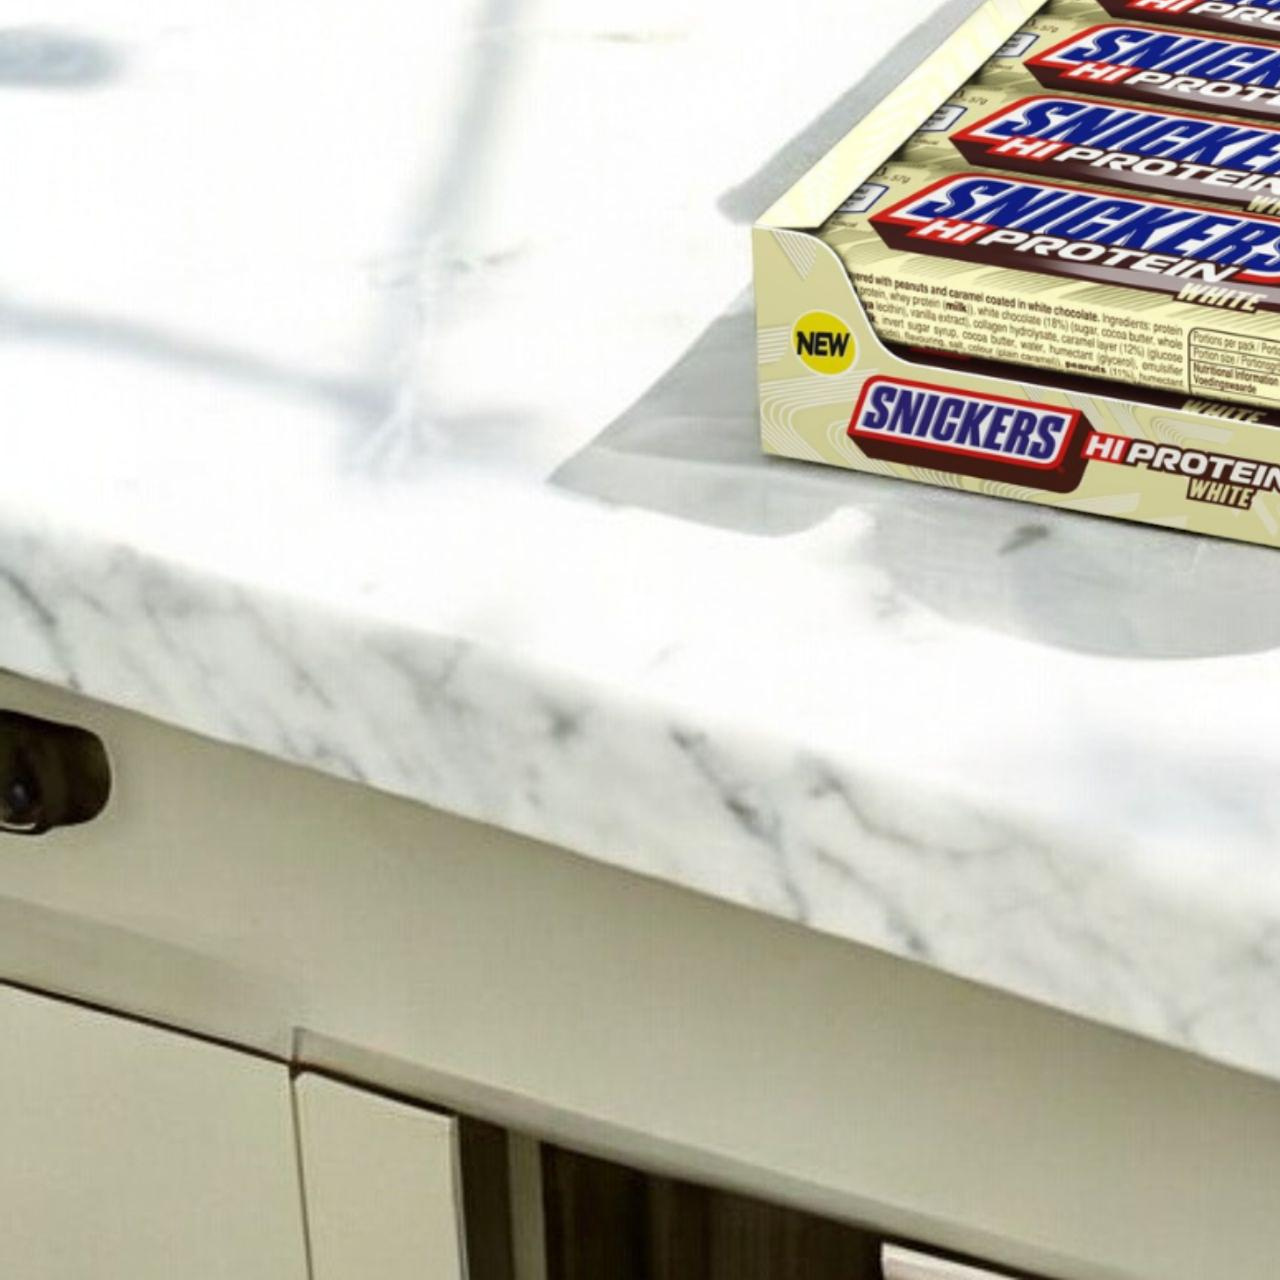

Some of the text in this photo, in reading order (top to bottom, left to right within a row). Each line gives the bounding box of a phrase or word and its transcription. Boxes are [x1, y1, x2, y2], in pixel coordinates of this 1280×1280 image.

[1069, 62, 1130, 81] HI
[996, 136, 1062, 158] HI
[916, 218, 1238, 283] HI PROTEIN
[875, 275, 892, 287] with
[894, 278, 928, 295] peanuts
[930, 284, 947, 296] and
[949, 288, 983, 302] caramel
[985, 294, 1015, 308] coated
[1018, 299, 1026, 310] in
[1028, 301, 1051, 314] white
[1152, 322, 1183, 338] protein
[1176, 282, 1268, 312] WHITE
[907, 321, 929, 335] sugar
[962, 330, 987, 343] cocoa
[977, 305, 999, 318] white
[1001, 309, 1041, 325] chocolate
[1101, 326, 1127, 340] cocoa
[1157, 336, 1183, 349] whole
[1061, 332, 1095, 347] caramel
[796, 331, 850, 357] NEW
[862, 384, 1066, 460] SNICKERS
[1085, 434, 1125, 461] HI
[1189, 479, 1255, 508] WHITE
